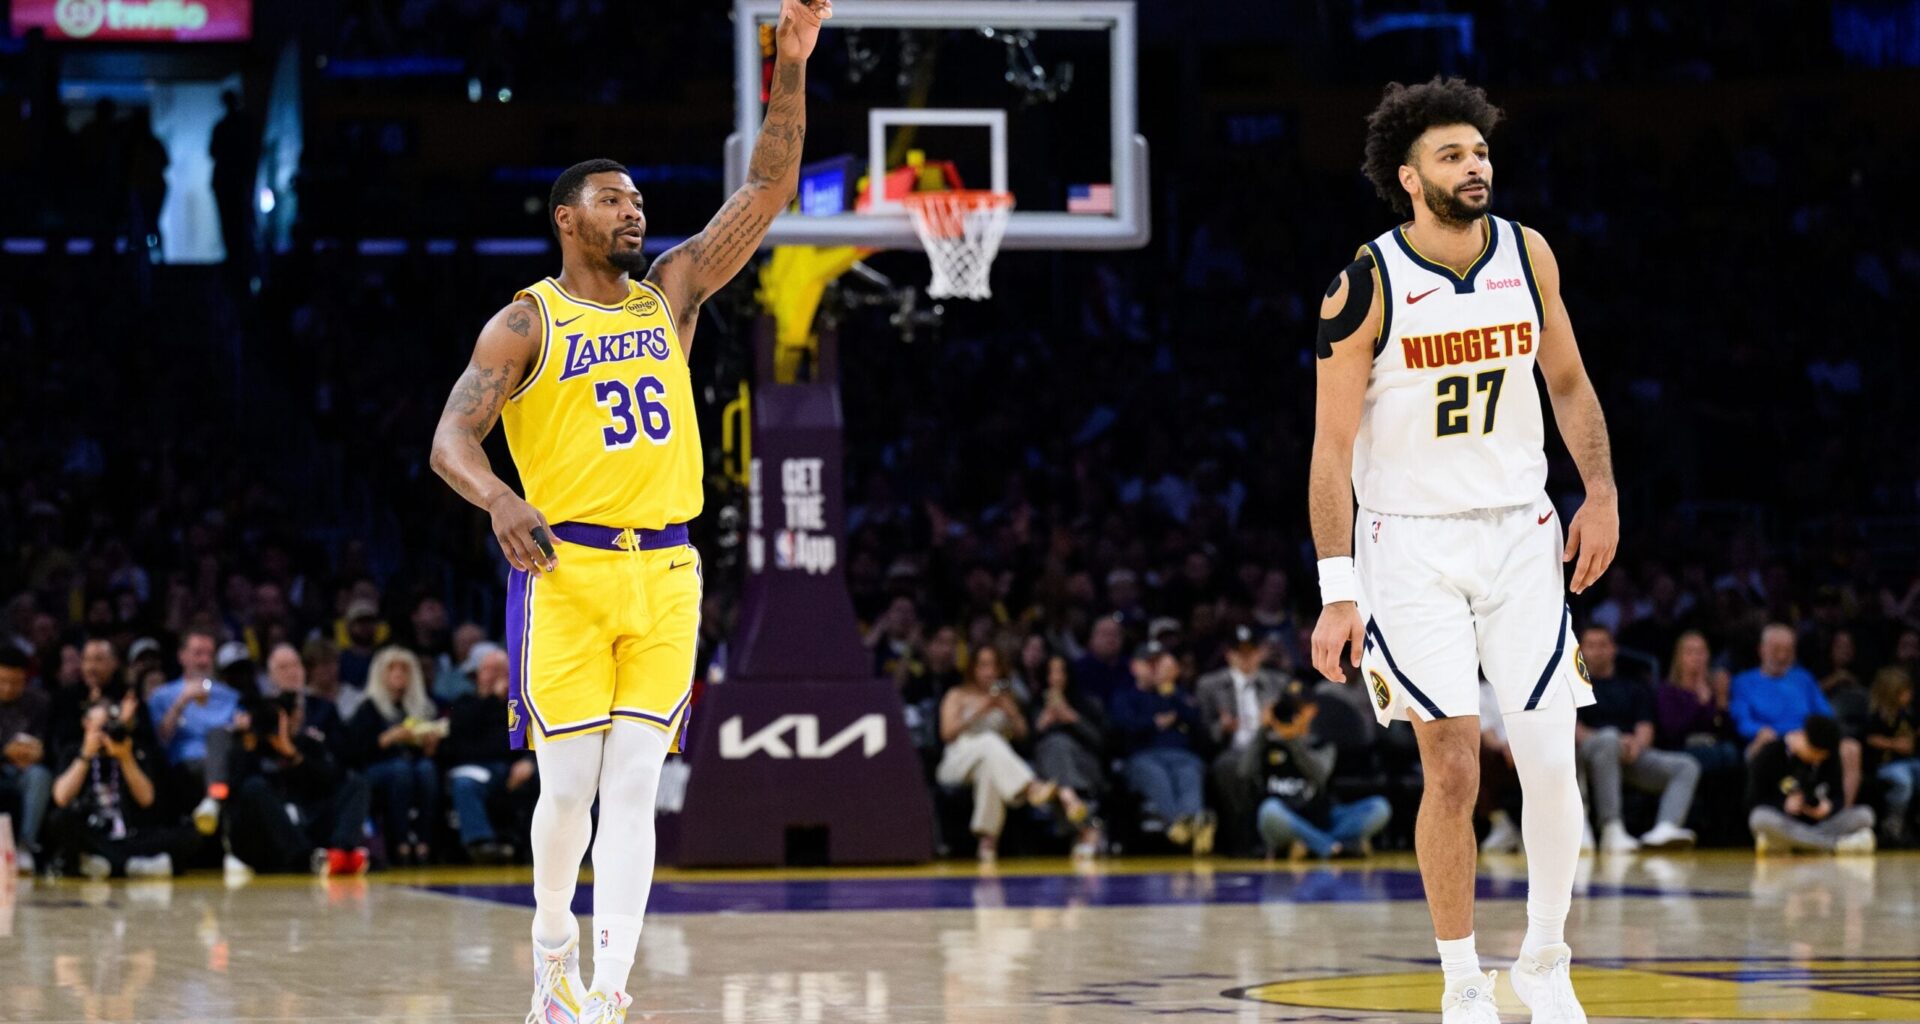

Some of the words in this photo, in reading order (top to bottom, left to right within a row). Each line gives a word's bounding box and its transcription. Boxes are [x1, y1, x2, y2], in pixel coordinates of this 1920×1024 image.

[628, 300, 656, 311] bibigo
[1486, 279, 1522, 290] ibotta
[558, 327, 670, 382] LAKERS
[1401, 322, 1533, 369] NUGGETS
[594, 375, 673, 451] 36
[1435, 366, 1508, 439] 27
[782, 458, 823, 493] GET
[783, 494, 826, 530] THE
[796, 530, 837, 574] App
[719, 713, 887, 759] KIA
